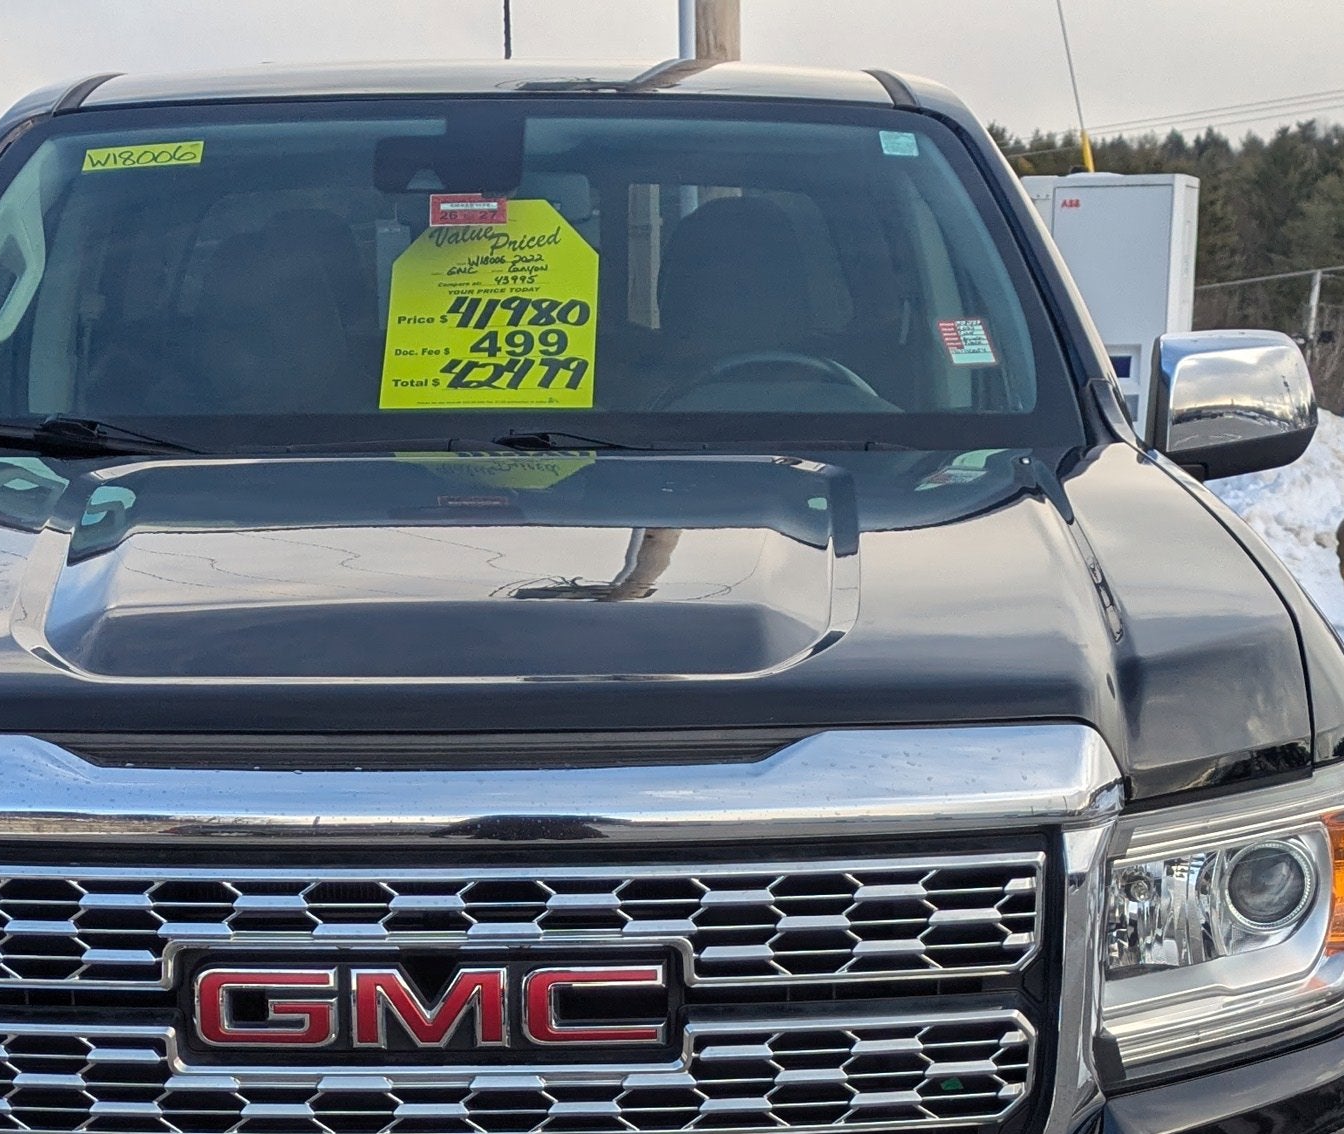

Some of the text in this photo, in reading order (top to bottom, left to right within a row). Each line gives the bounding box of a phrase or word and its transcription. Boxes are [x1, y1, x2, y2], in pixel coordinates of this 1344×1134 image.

[88, 146, 196, 168] W18006
[429, 226, 561, 256] Value Priced
[512, 254, 544, 264] 2022
[494, 274, 537, 285] 43995
[397, 296, 591, 330] Price $ 41980
[394, 348, 418, 356] Doc.
[421, 348, 440, 356] Fee
[469, 329, 569, 358] 499
[392, 357, 589, 390] Total $ 42479
[195, 964, 667, 1048] GMC
